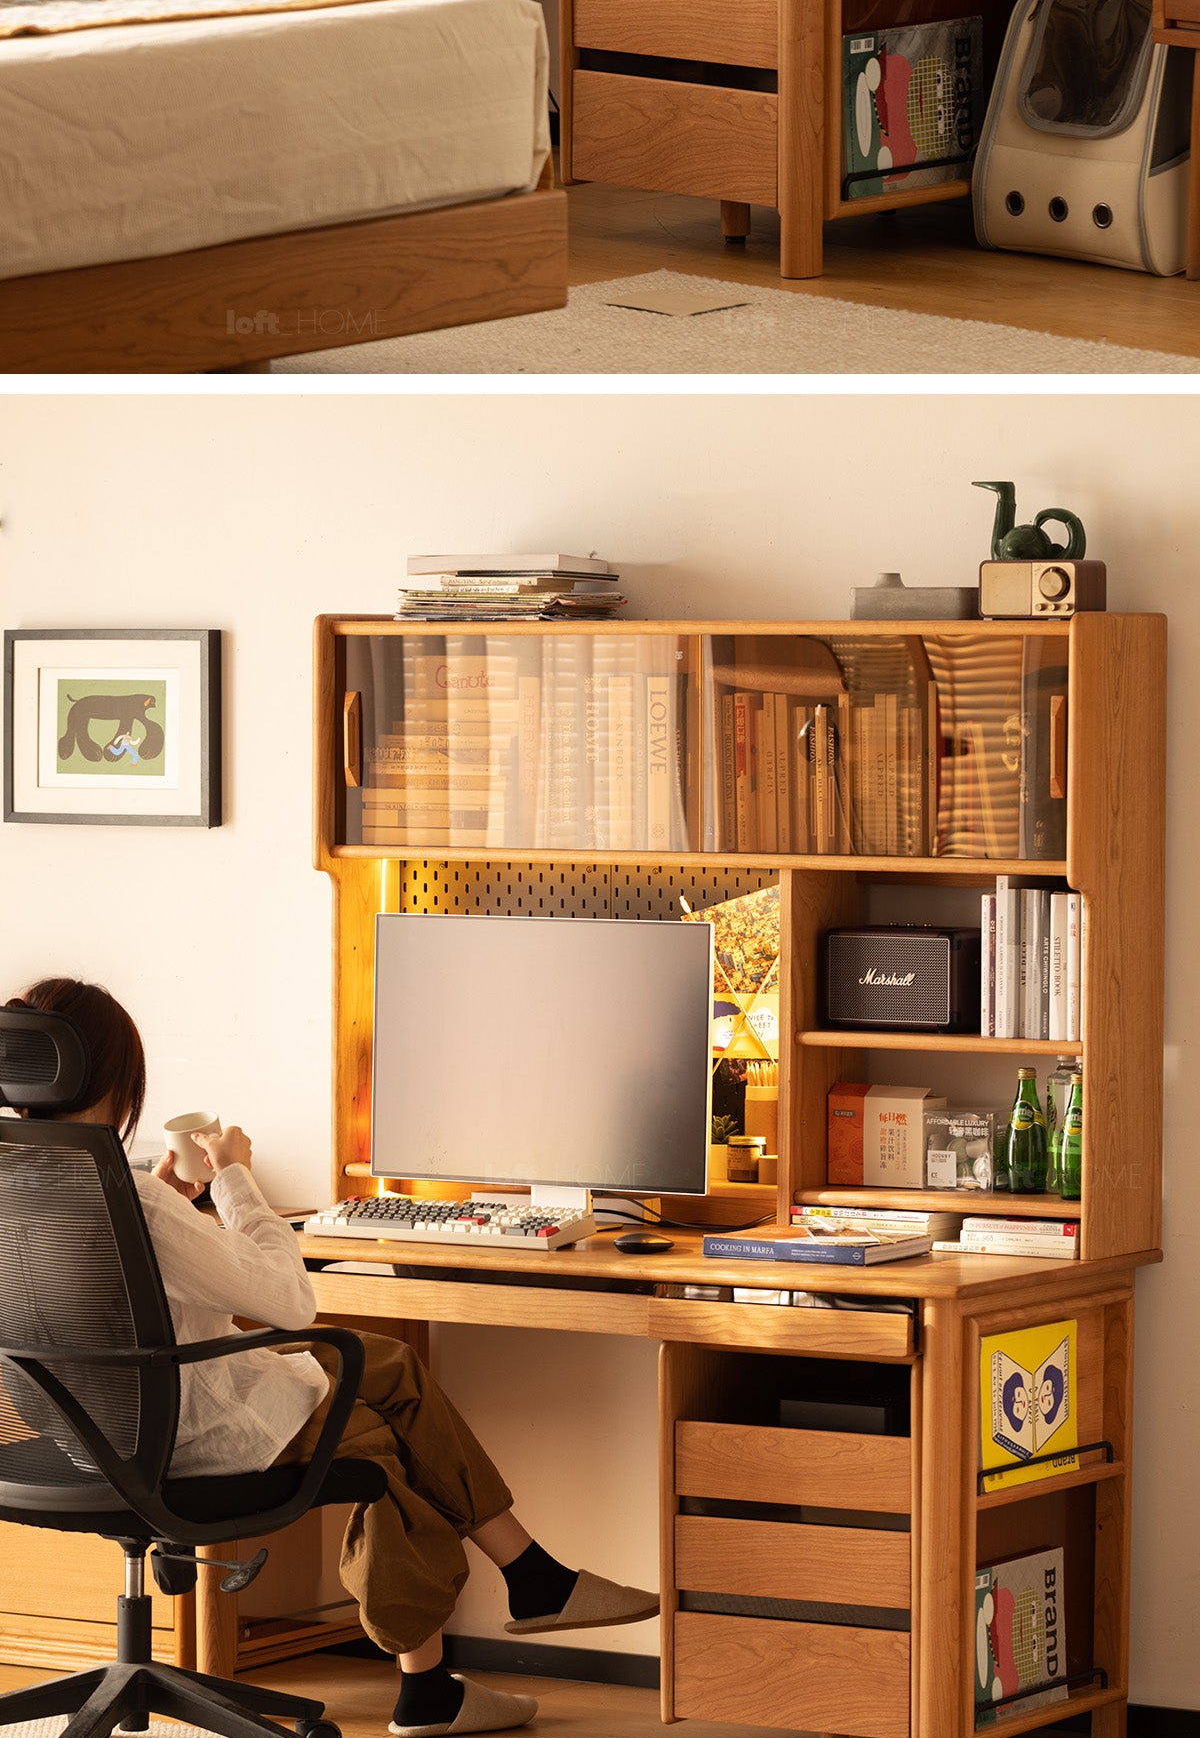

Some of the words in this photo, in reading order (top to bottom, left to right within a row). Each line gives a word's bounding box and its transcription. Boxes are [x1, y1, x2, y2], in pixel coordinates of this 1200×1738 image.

[649, 689, 668, 775] LOEWE
[858, 968, 916, 987] Marshall
[965, 1120, 989, 1128] LUXURY
[709, 1243, 742, 1253] COOKING
[742, 1245, 750, 1253] IN
[751, 1246, 775, 1255] MARFA
